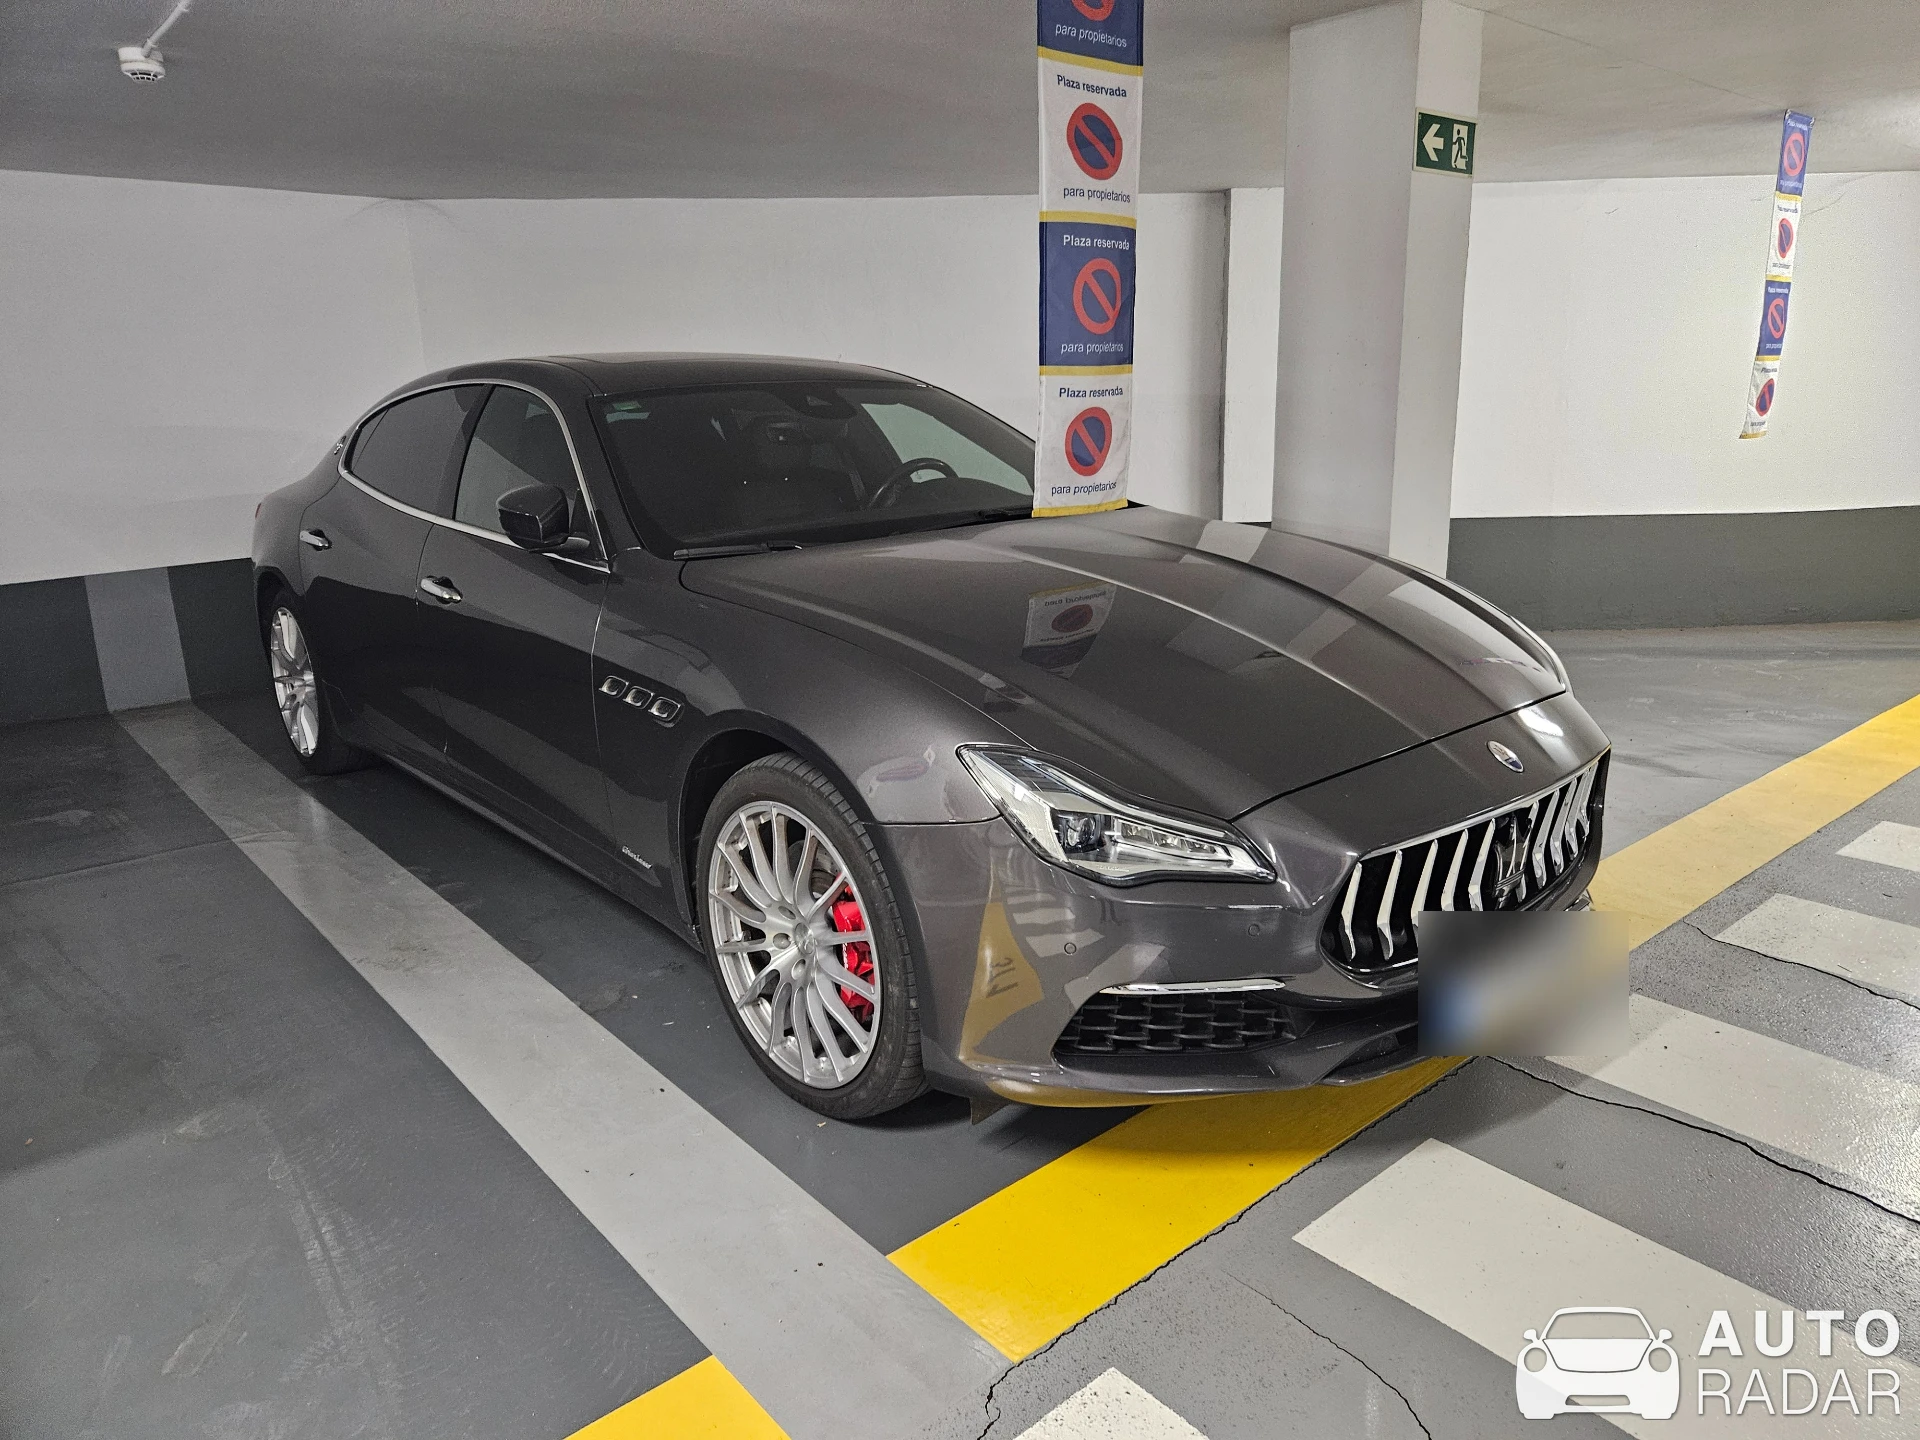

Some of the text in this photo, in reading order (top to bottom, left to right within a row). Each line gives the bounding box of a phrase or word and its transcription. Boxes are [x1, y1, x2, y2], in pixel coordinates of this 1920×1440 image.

[1055, 23, 1127, 48] para propietarios
[1057, 74, 1127, 98] Plaza reservada
[1063, 187, 1131, 204] para propietarios
[1063, 234, 1130, 251] Plaza reservada
[1061, 341, 1124, 355] para propietarios
[1059, 386, 1124, 398] Plaza reservada
[1051, 481, 1117, 497] para propietarios
